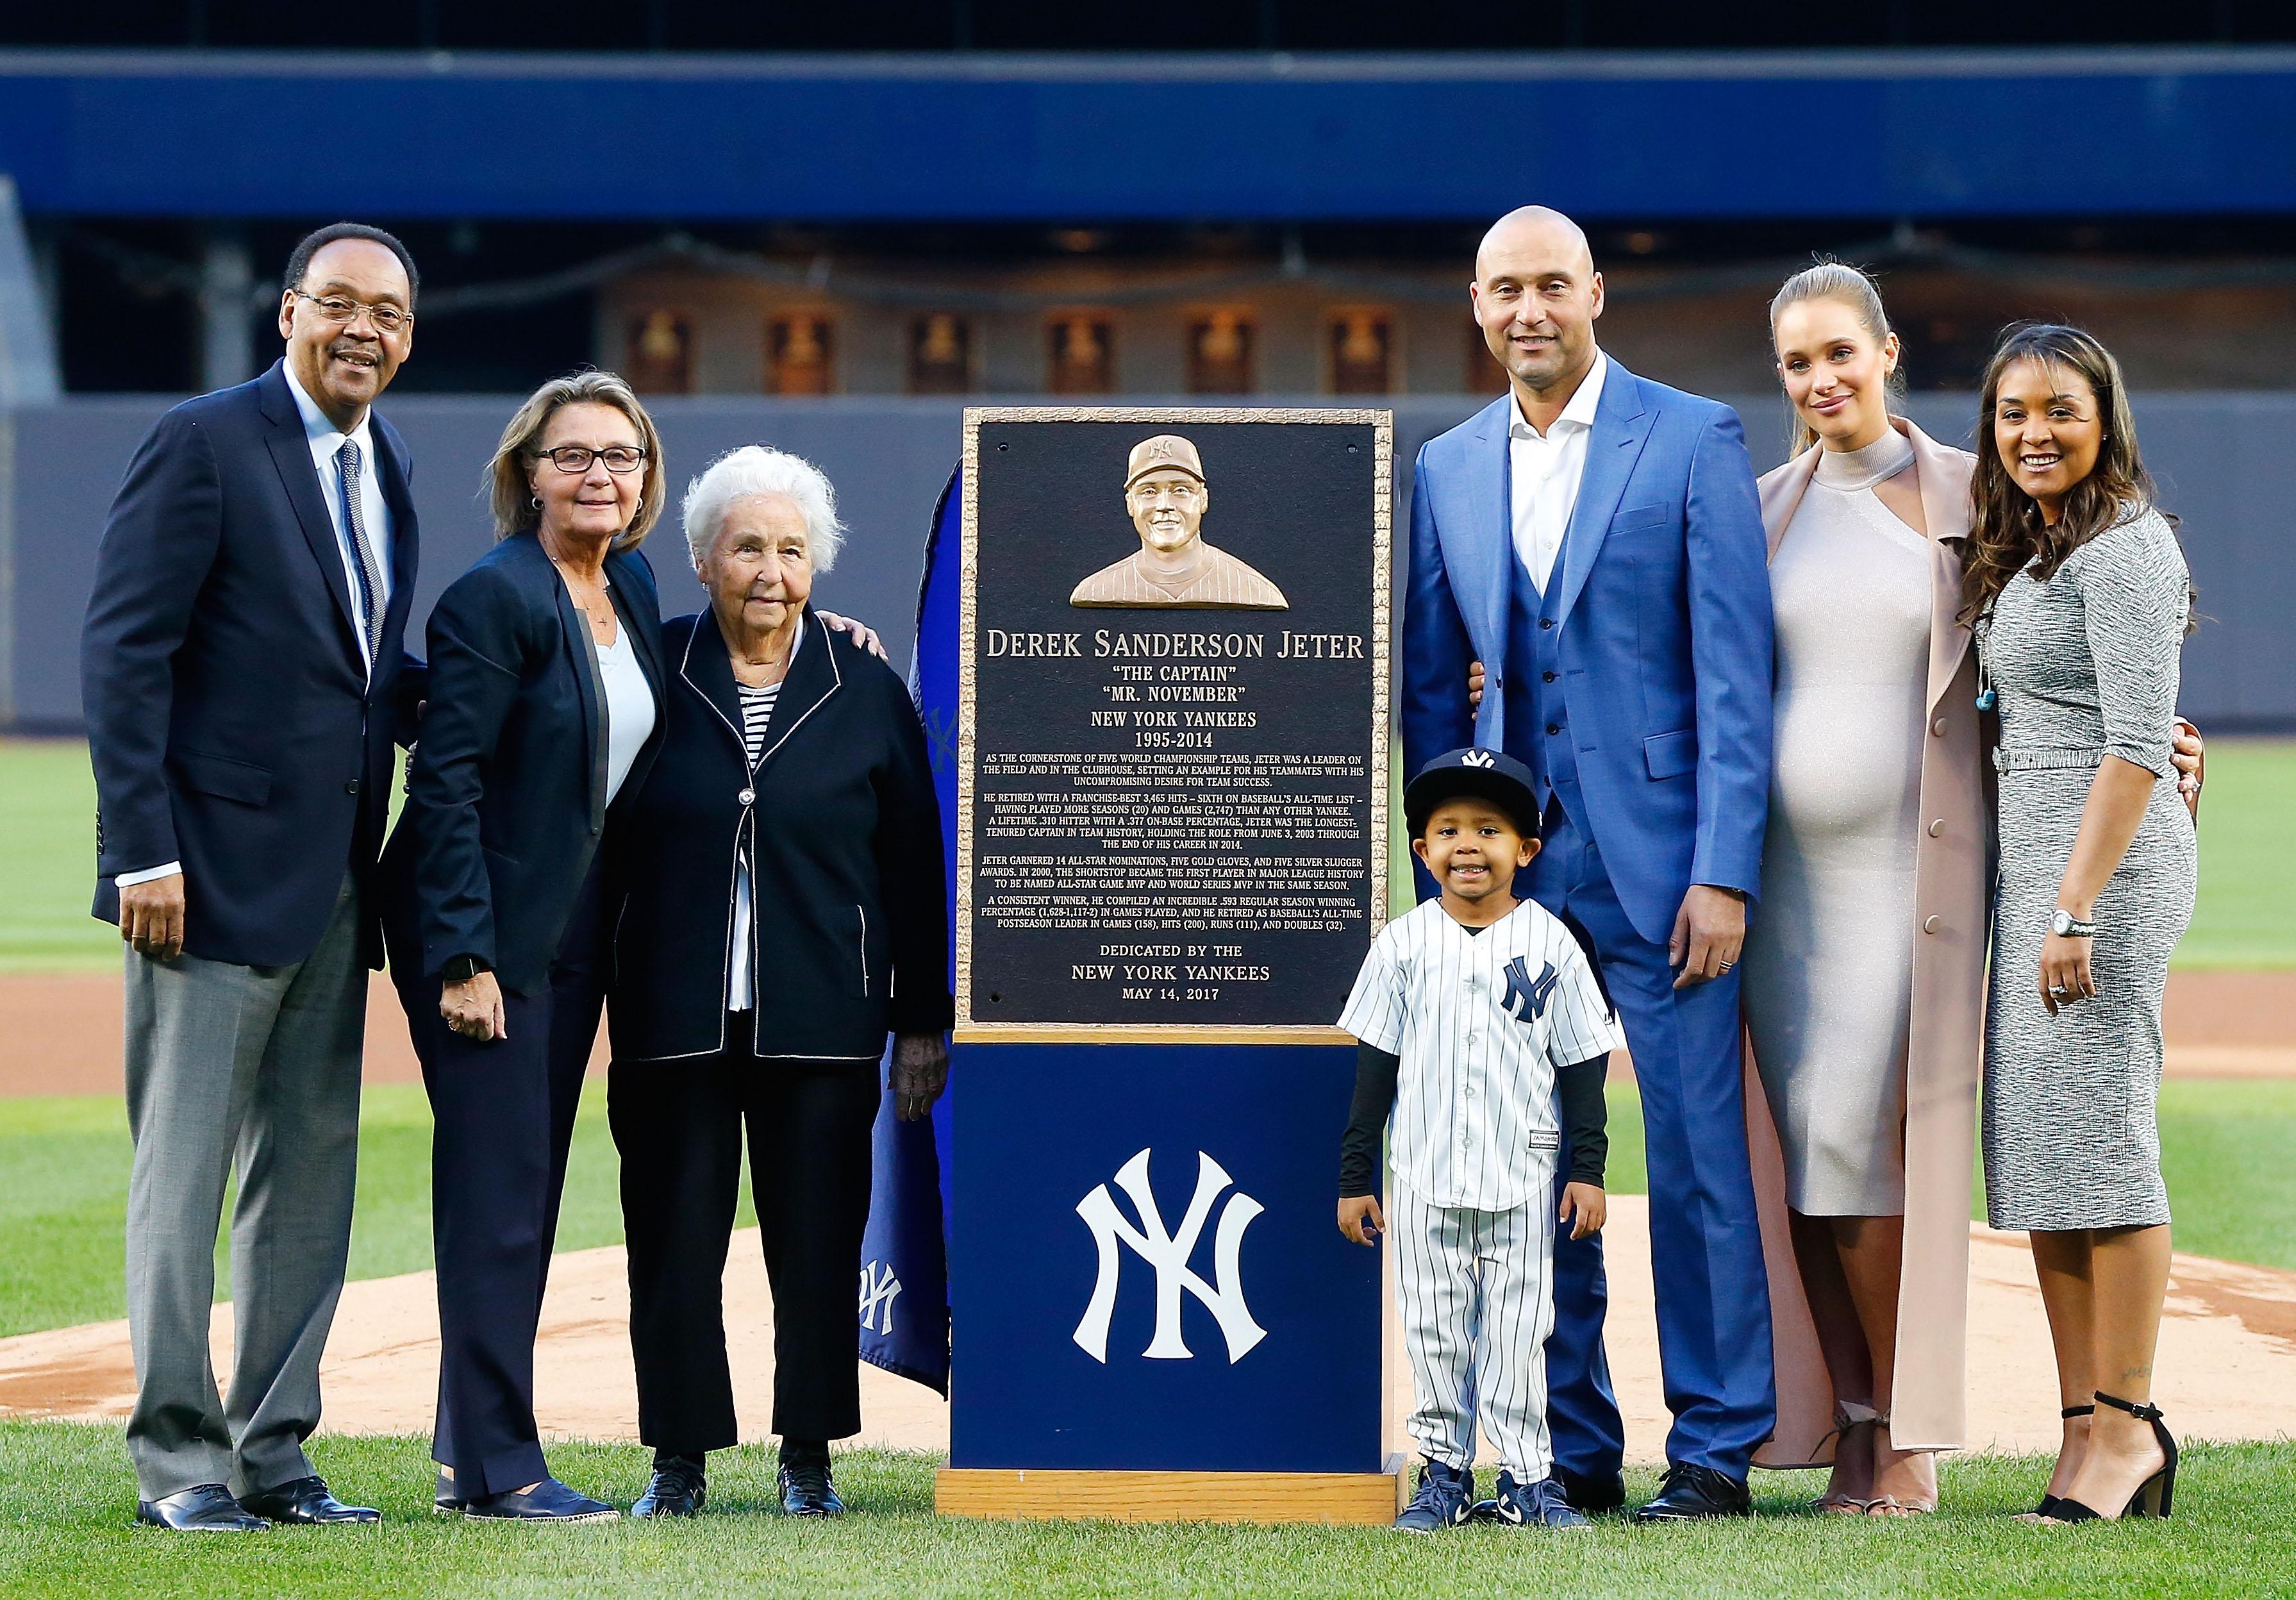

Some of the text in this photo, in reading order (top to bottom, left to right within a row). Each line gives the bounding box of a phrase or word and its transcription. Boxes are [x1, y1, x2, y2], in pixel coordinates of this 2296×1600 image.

[1149, 439, 1173, 458] NY
[987, 628, 1365, 659] DEREK SANDERSON JETER
[1112, 665, 1236, 681] “THE CAPTAIN”
[1102, 685, 1245, 702] “MR. NOVEMBER”
[1090, 711, 1256, 728] NEW YORK YANKEES
[1135, 731, 1213, 748] 1995-2014
[985, 753, 1362, 765] AS THE CORNERSTONE OF FIVE WORLD CHAMPIONSHIP TEAMS, JETER WAS A LEADER ON
[982, 764, 1365, 777] THE FIELD AND IN THE CLUBHOUSE, SETTING AN EXAMPLE FOR HIS TEAMMATES WITH HIS
[1073, 776, 1272, 787] UNCOMPROMISING DESIRE FOR TEAM SUCCESS.
[994, 804, 1351, 817] HAVING PLAYED MORE SEASONS (20) AND GAMES (2,747) THAN ANY OTHER YANKEE.
[985, 827, 1360, 840] TENURED CAPTAIN IN TEAM HISTORY, HOLDING THE ROLE FROM JUNE 3, 2003 THROUGH
[1101, 839, 1243, 850] THE END OF HIS CAREER IN 2014.
[981, 855, 1363, 868] JETER GARNERED 14 ALL-STAR NOMINATIONS, FIVE GOLD GLOVES, AND FIVE SILVER SLUGGER
[979, 867, 1365, 879] AWARDS. IN 2000, THE SHORTSTOP BECAME THE FIRST PLAYER IN MAJOR LEAGUE HISTORY
[987, 895, 1356, 908] A CONSISTENT WINNER, HE COMPILED AN INCREDIBLE .593 REGULAR SEASON WINNING
[981, 906, 1363, 919] PERCENTAGE (1,628-1,117-2) IN GAMES PLAYED, AND HE RETIRED AS BASEBALL’S ALL-TIME
[997, 918, 1346, 932] POSTSEASON LEADER IN GAMES (158), HITS (200), RUNS (111), AND DOUBLES (32).
[1097, 944, 1242, 957] DEDICATED BY THE
[1071, 965, 1270, 982] NEW YORK YANKEES
[1122, 987, 1219, 1002] MAY 14, 2017
[1501, 955, 1559, 1024] NY
[1072, 1146, 1269, 1365] NY
